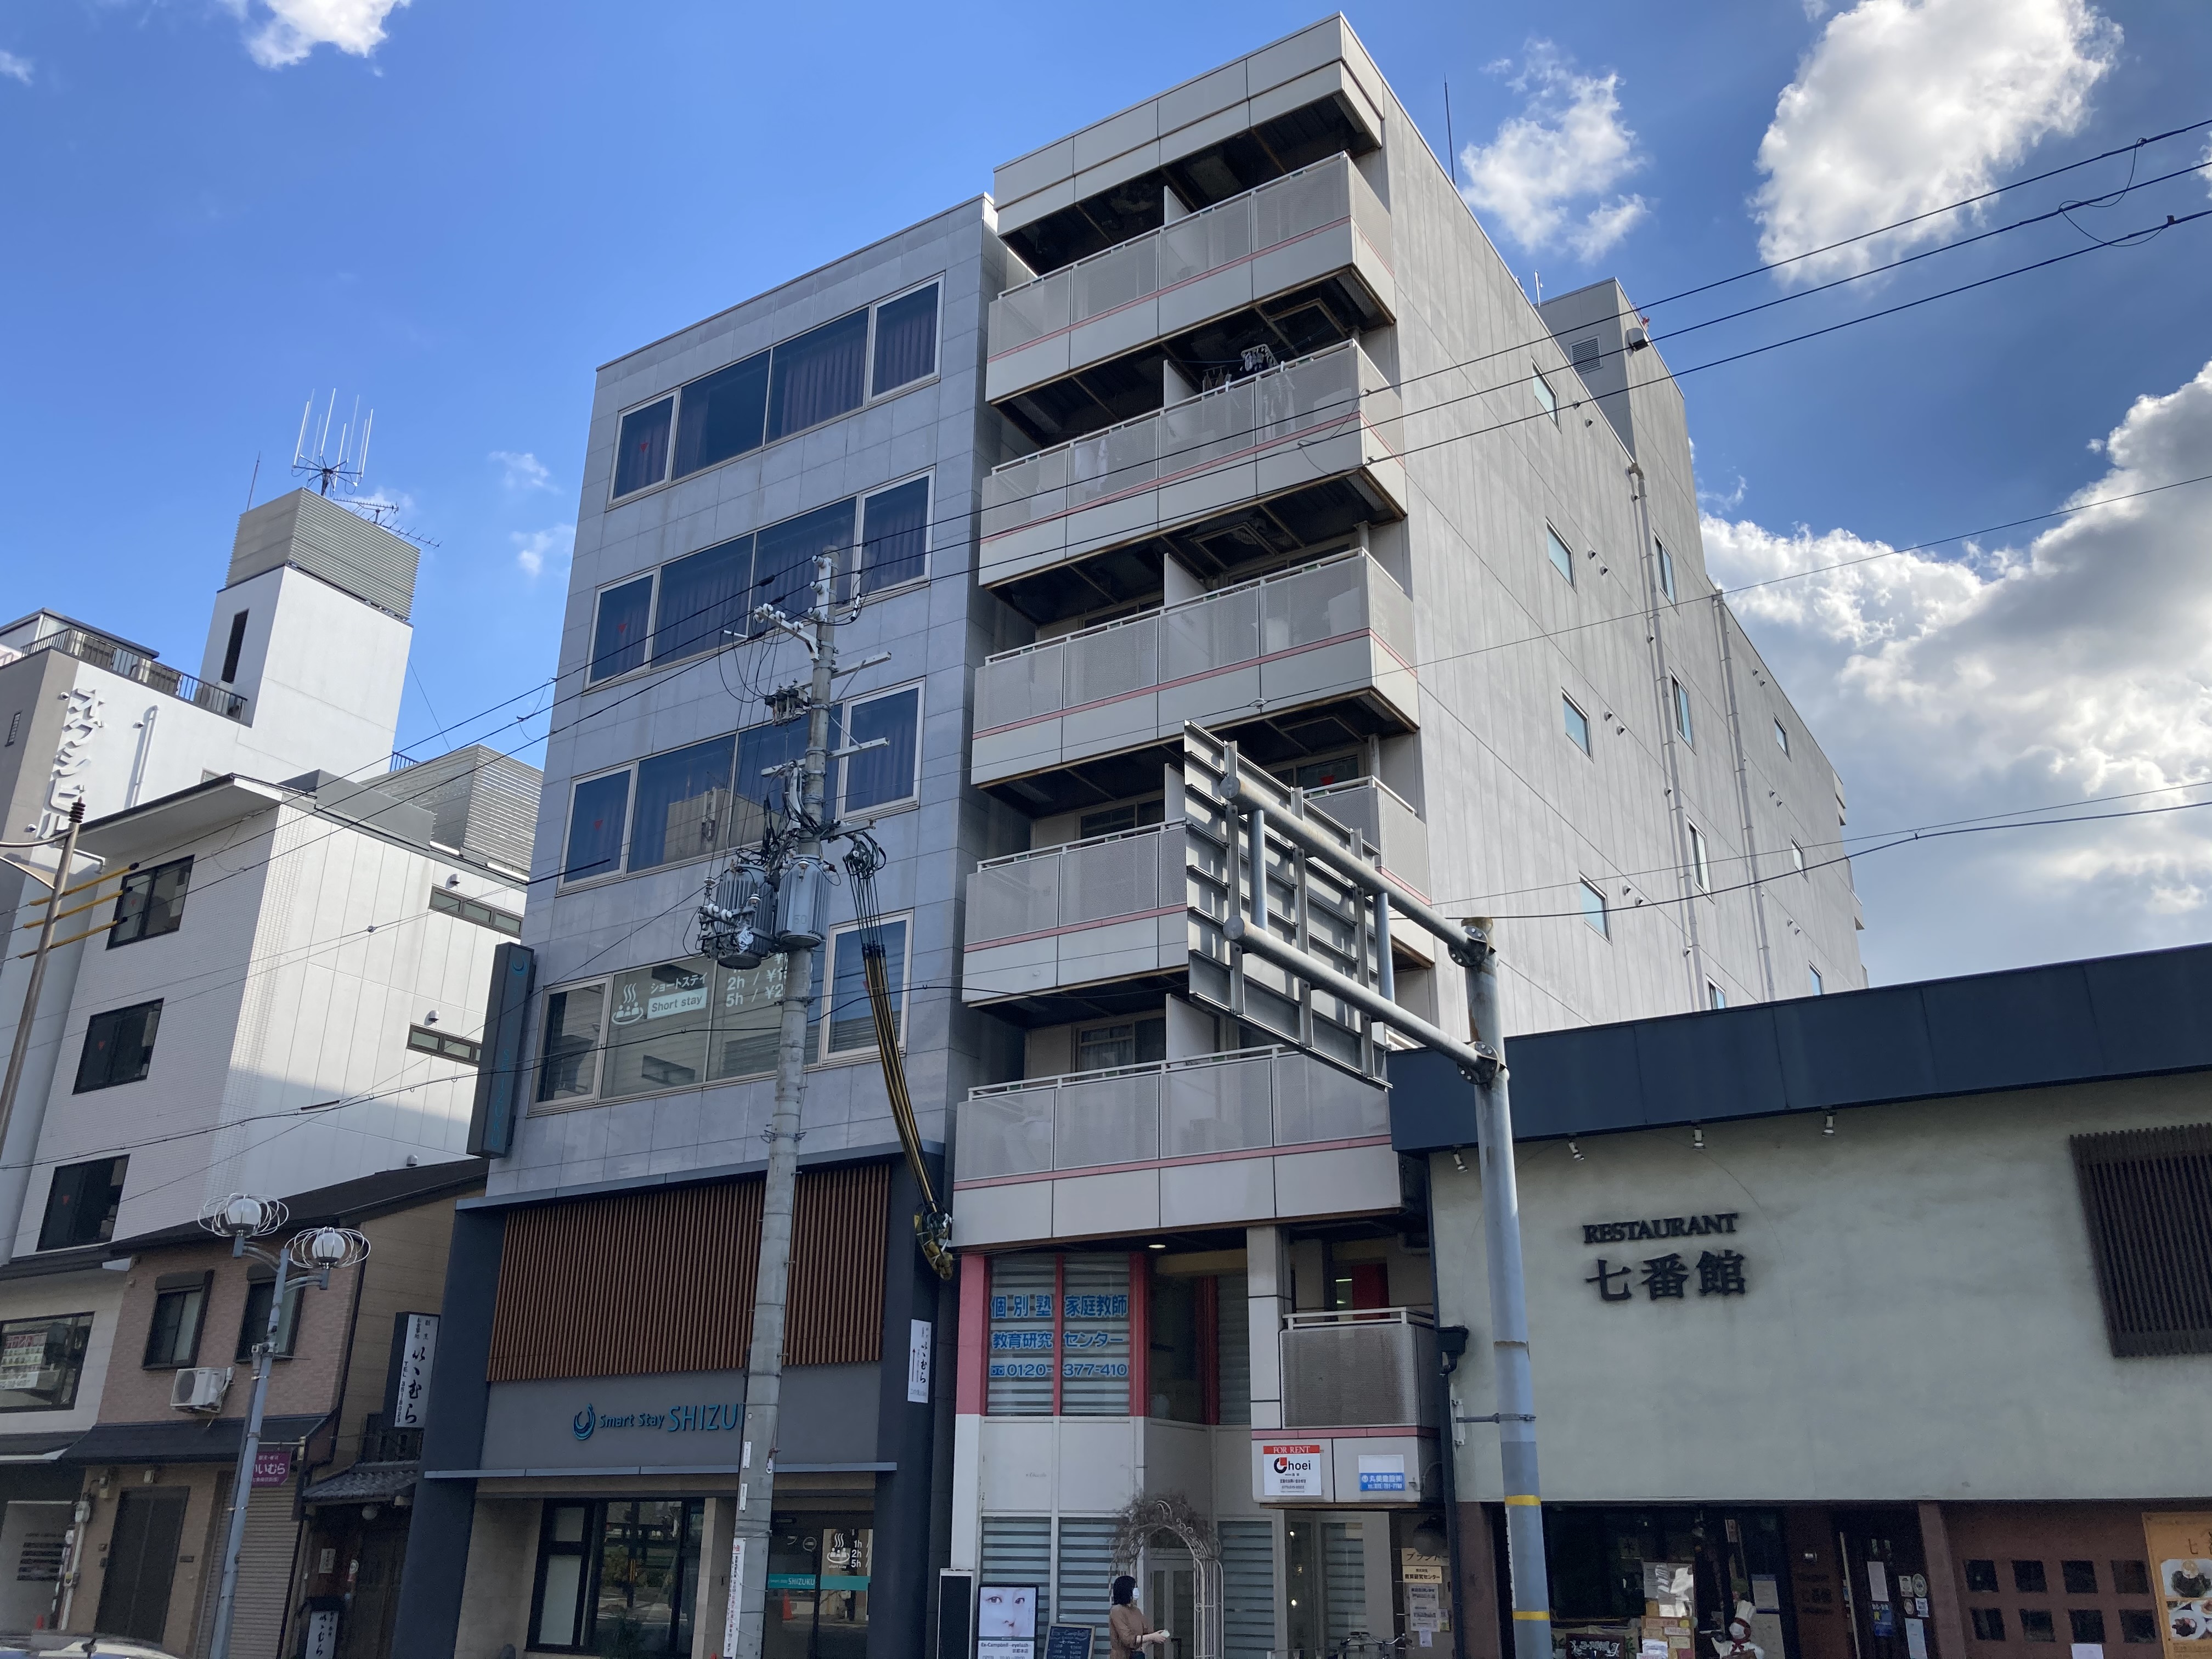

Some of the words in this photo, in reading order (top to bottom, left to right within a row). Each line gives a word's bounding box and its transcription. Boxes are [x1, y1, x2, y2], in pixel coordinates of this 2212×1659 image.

[794, 915, 807, 924] 50
[651, 972, 708, 995] ショートステイ
[727, 975, 745, 991] 2h
[652, 999, 678, 1012] Short
[681, 996, 703, 1007] stay
[726, 992, 743, 1007] 5h
[490, 1048, 510, 1147] SHIZUKU
[1583, 1212, 1739, 1244] RESTAURANT
[1585, 1249, 1746, 1301] 七番館
[991, 1295, 1052, 1318] 個別塾
[1065, 1294, 1128, 1317] 家庭教師
[992, 1331, 1053, 1350] 教育研究
[1064, 1331, 1124, 1347] センター
[1007, 1364, 1053, 1376] 0120-
[1063, 1364, 1128, 1376] 377-410
[599, 1414, 634, 1427] Smart
[638, 1413, 665, 1429] Stay
[667, 1403, 742, 1432] SHIZU
[1274, 1457, 1311, 1474] Choei
[854, 1539, 862, 1548] 1h
[851, 1549, 862, 1558] 2h
[851, 1559, 861, 1568] 5h
[788, 1577, 816, 1585] SHIZUKU
